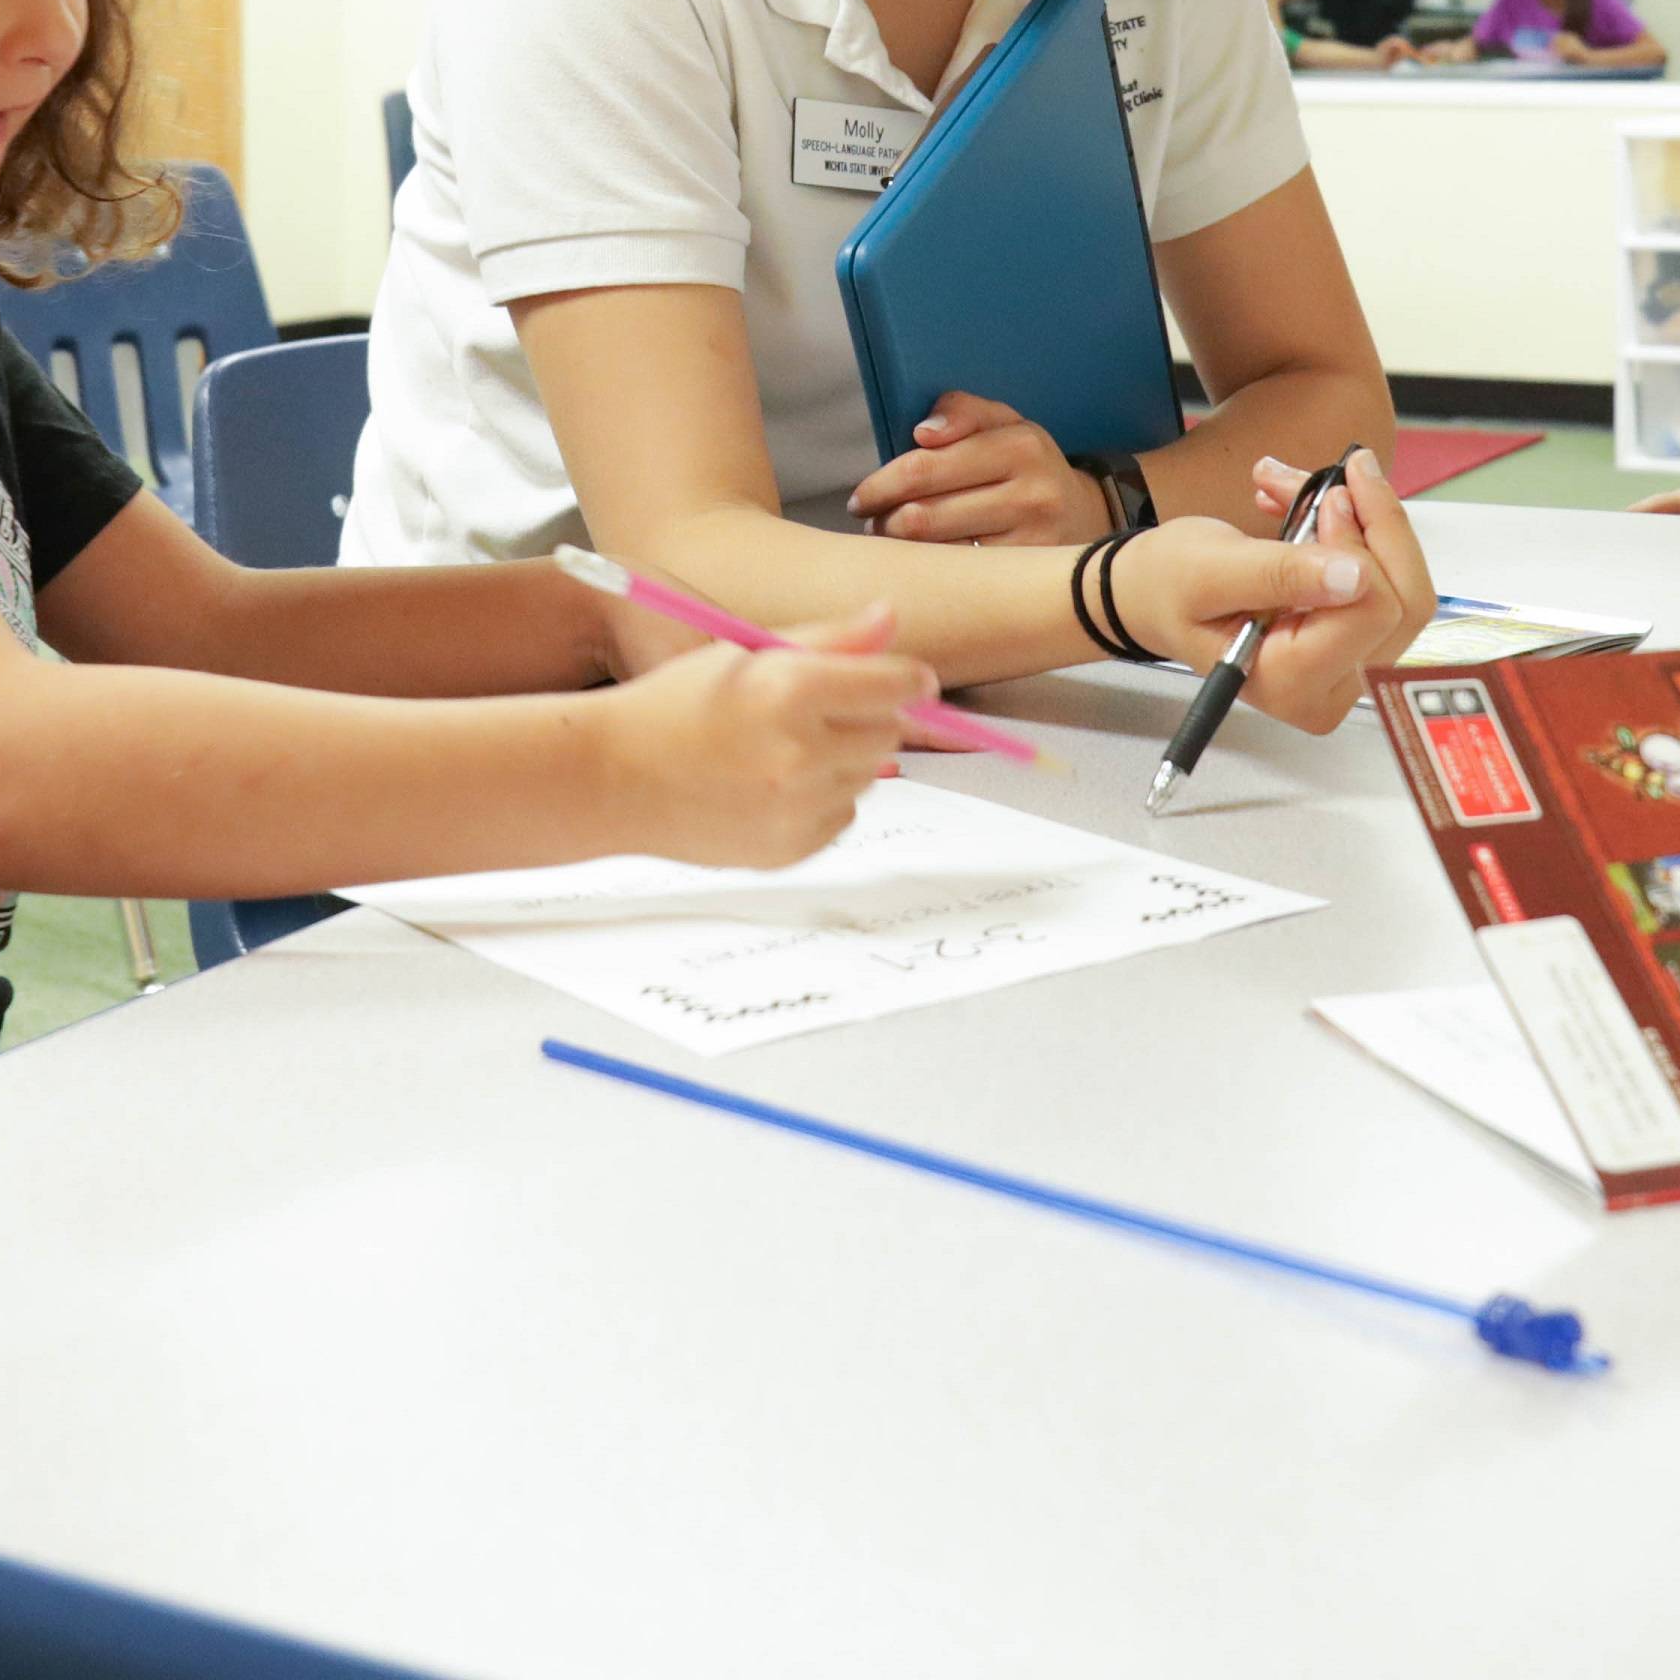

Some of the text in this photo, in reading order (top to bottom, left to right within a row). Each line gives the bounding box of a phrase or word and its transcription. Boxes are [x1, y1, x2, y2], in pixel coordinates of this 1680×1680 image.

[843, 118, 885, 143] Molly
[801, 138, 876, 158] SPEECH-LANGUAGE
[824, 159, 848, 173] WICHITA
[849, 162, 867, 175] STATE
